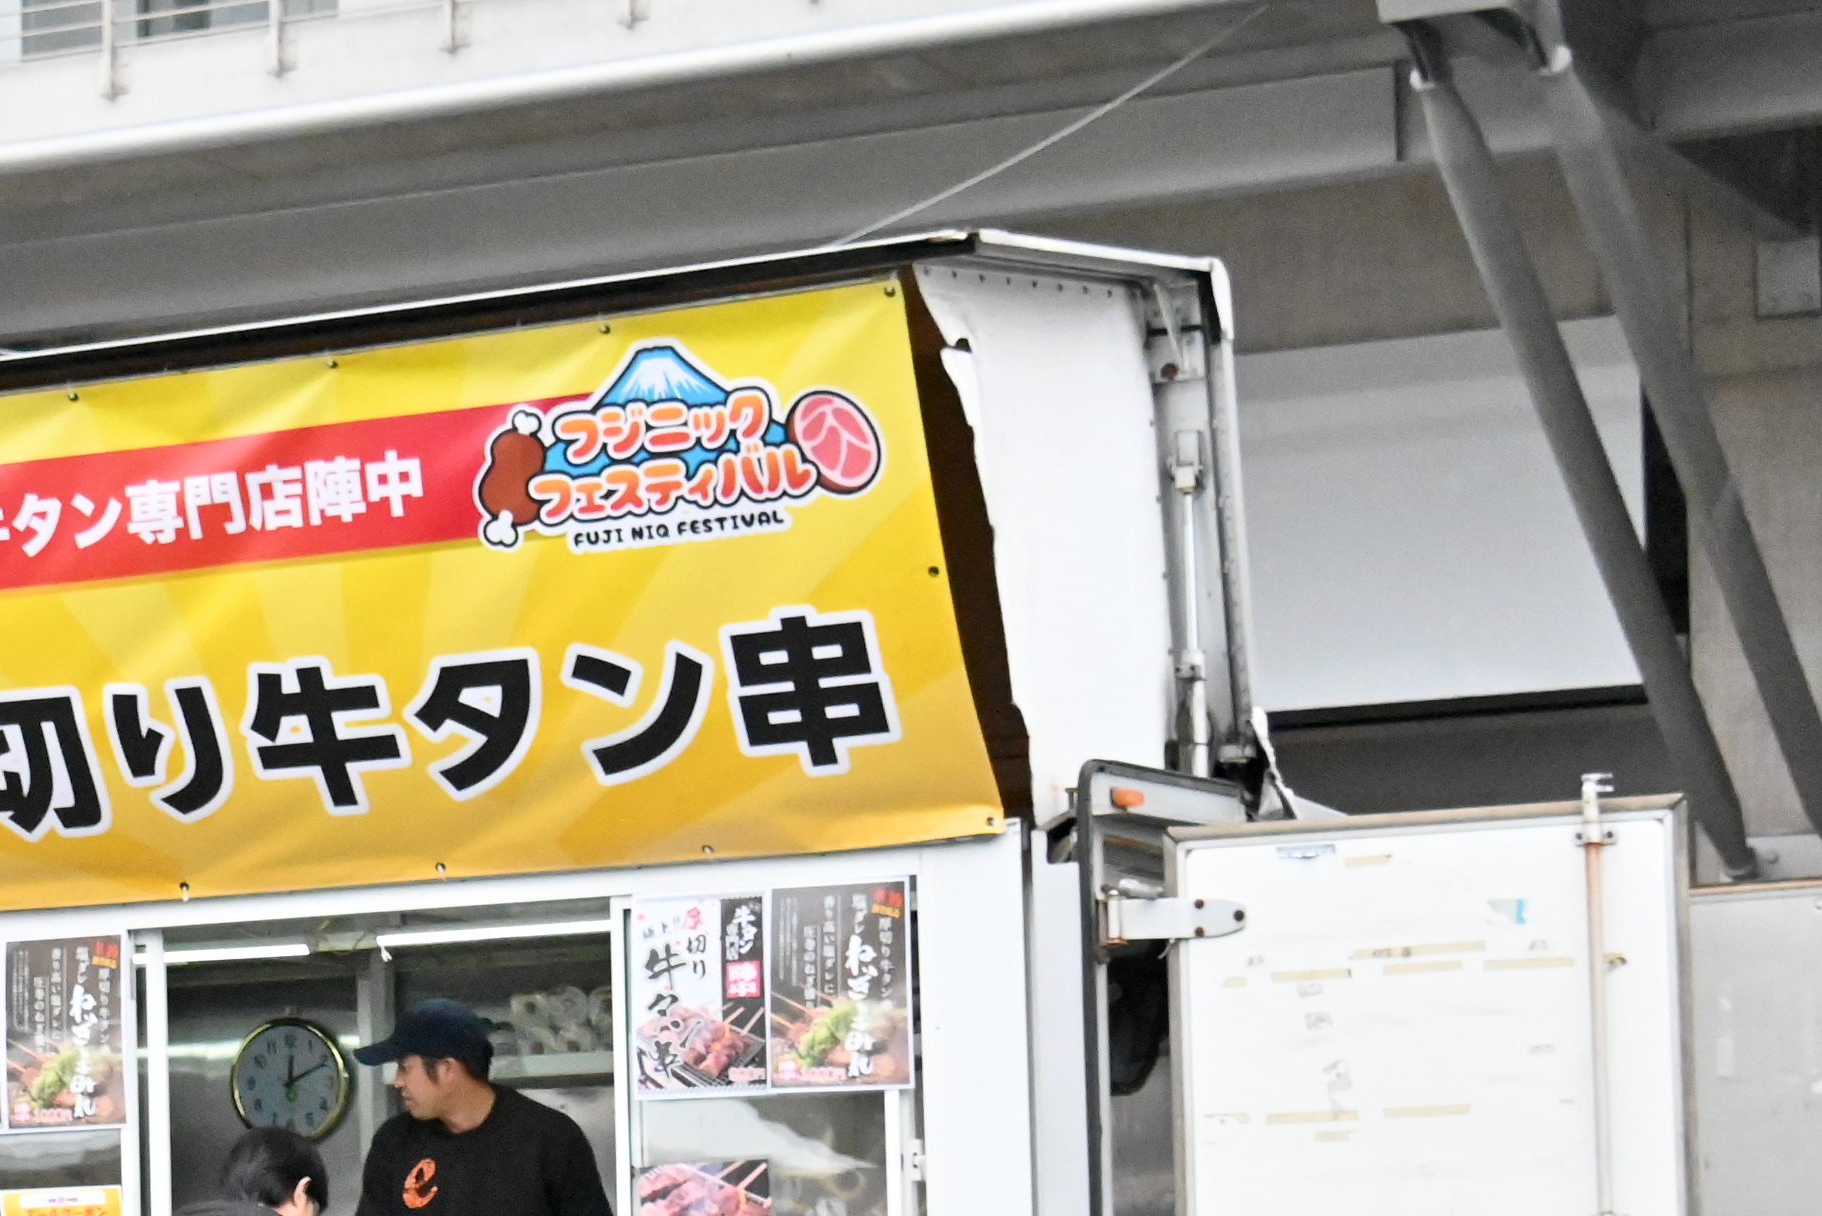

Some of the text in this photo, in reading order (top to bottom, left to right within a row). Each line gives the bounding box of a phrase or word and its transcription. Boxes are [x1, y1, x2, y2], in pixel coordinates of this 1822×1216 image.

[559, 394, 765, 464] フジニック
[533, 444, 815, 519] フェスティバル
[574, 511, 785, 548] FUJI NIQ FESTIVAL
